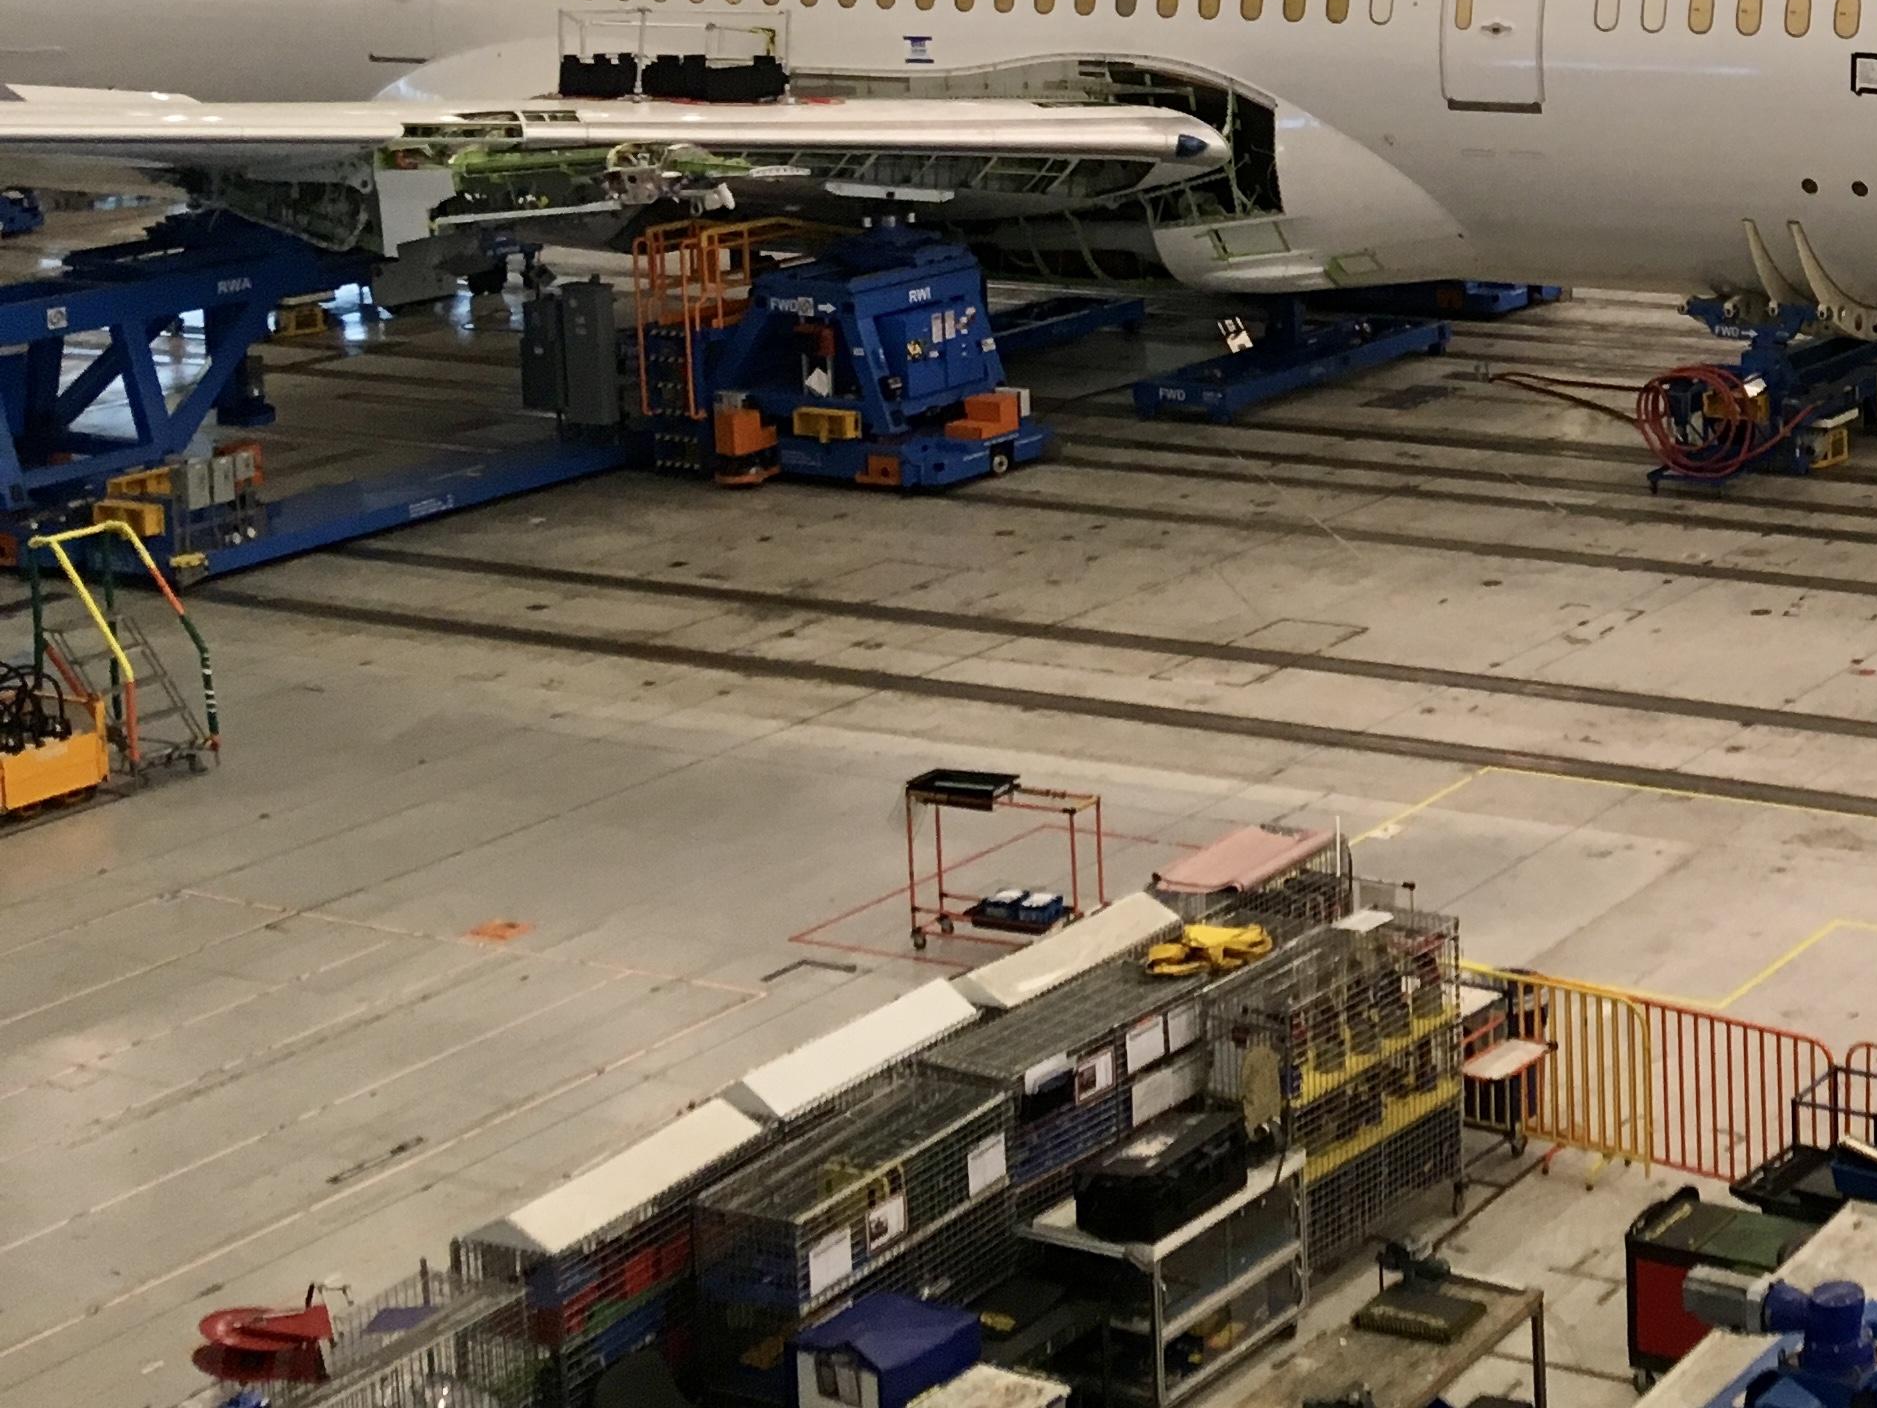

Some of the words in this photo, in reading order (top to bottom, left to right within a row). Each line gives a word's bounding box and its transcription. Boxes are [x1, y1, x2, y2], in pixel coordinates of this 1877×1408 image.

[217, 277, 252, 295] RWA
[908, 286, 932, 304] RWI
[770, 297, 799, 312] FWD
[1159, 387, 1186, 401] FWD
